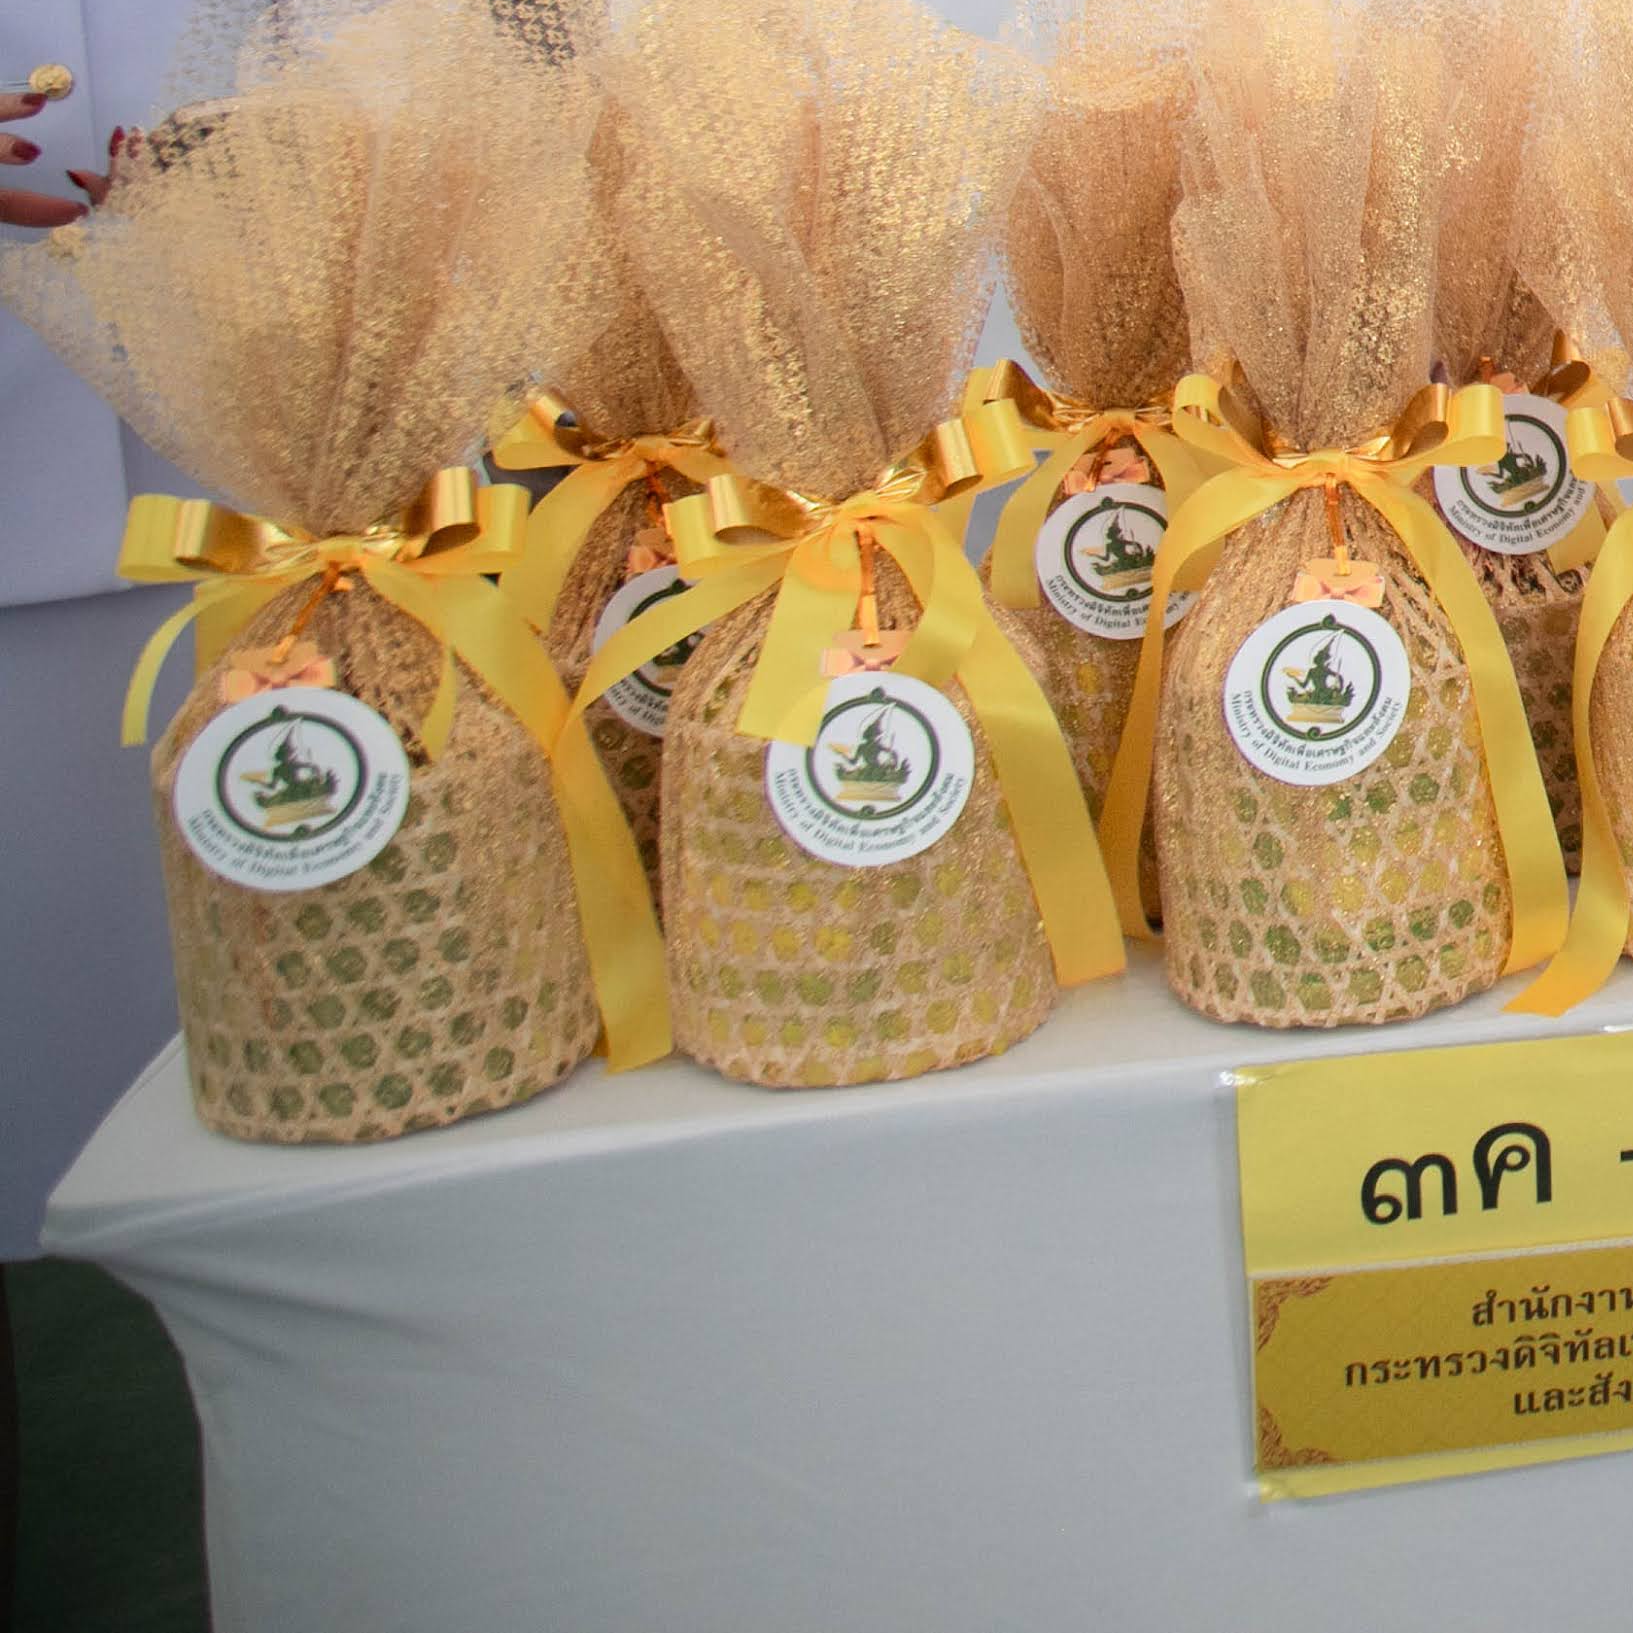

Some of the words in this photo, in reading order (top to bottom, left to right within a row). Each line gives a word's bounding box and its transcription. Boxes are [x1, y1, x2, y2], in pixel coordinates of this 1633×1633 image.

[1232, 693, 1250, 738] Ministry
[1252, 740, 1263, 750] of
[1264, 748, 1300, 769] Digital
[1304, 756, 1354, 771] Economy
[1359, 739, 1376, 756] and
[1377, 701, 1401, 738] Society
[1360, 1121, 1554, 1227] ๓ค
